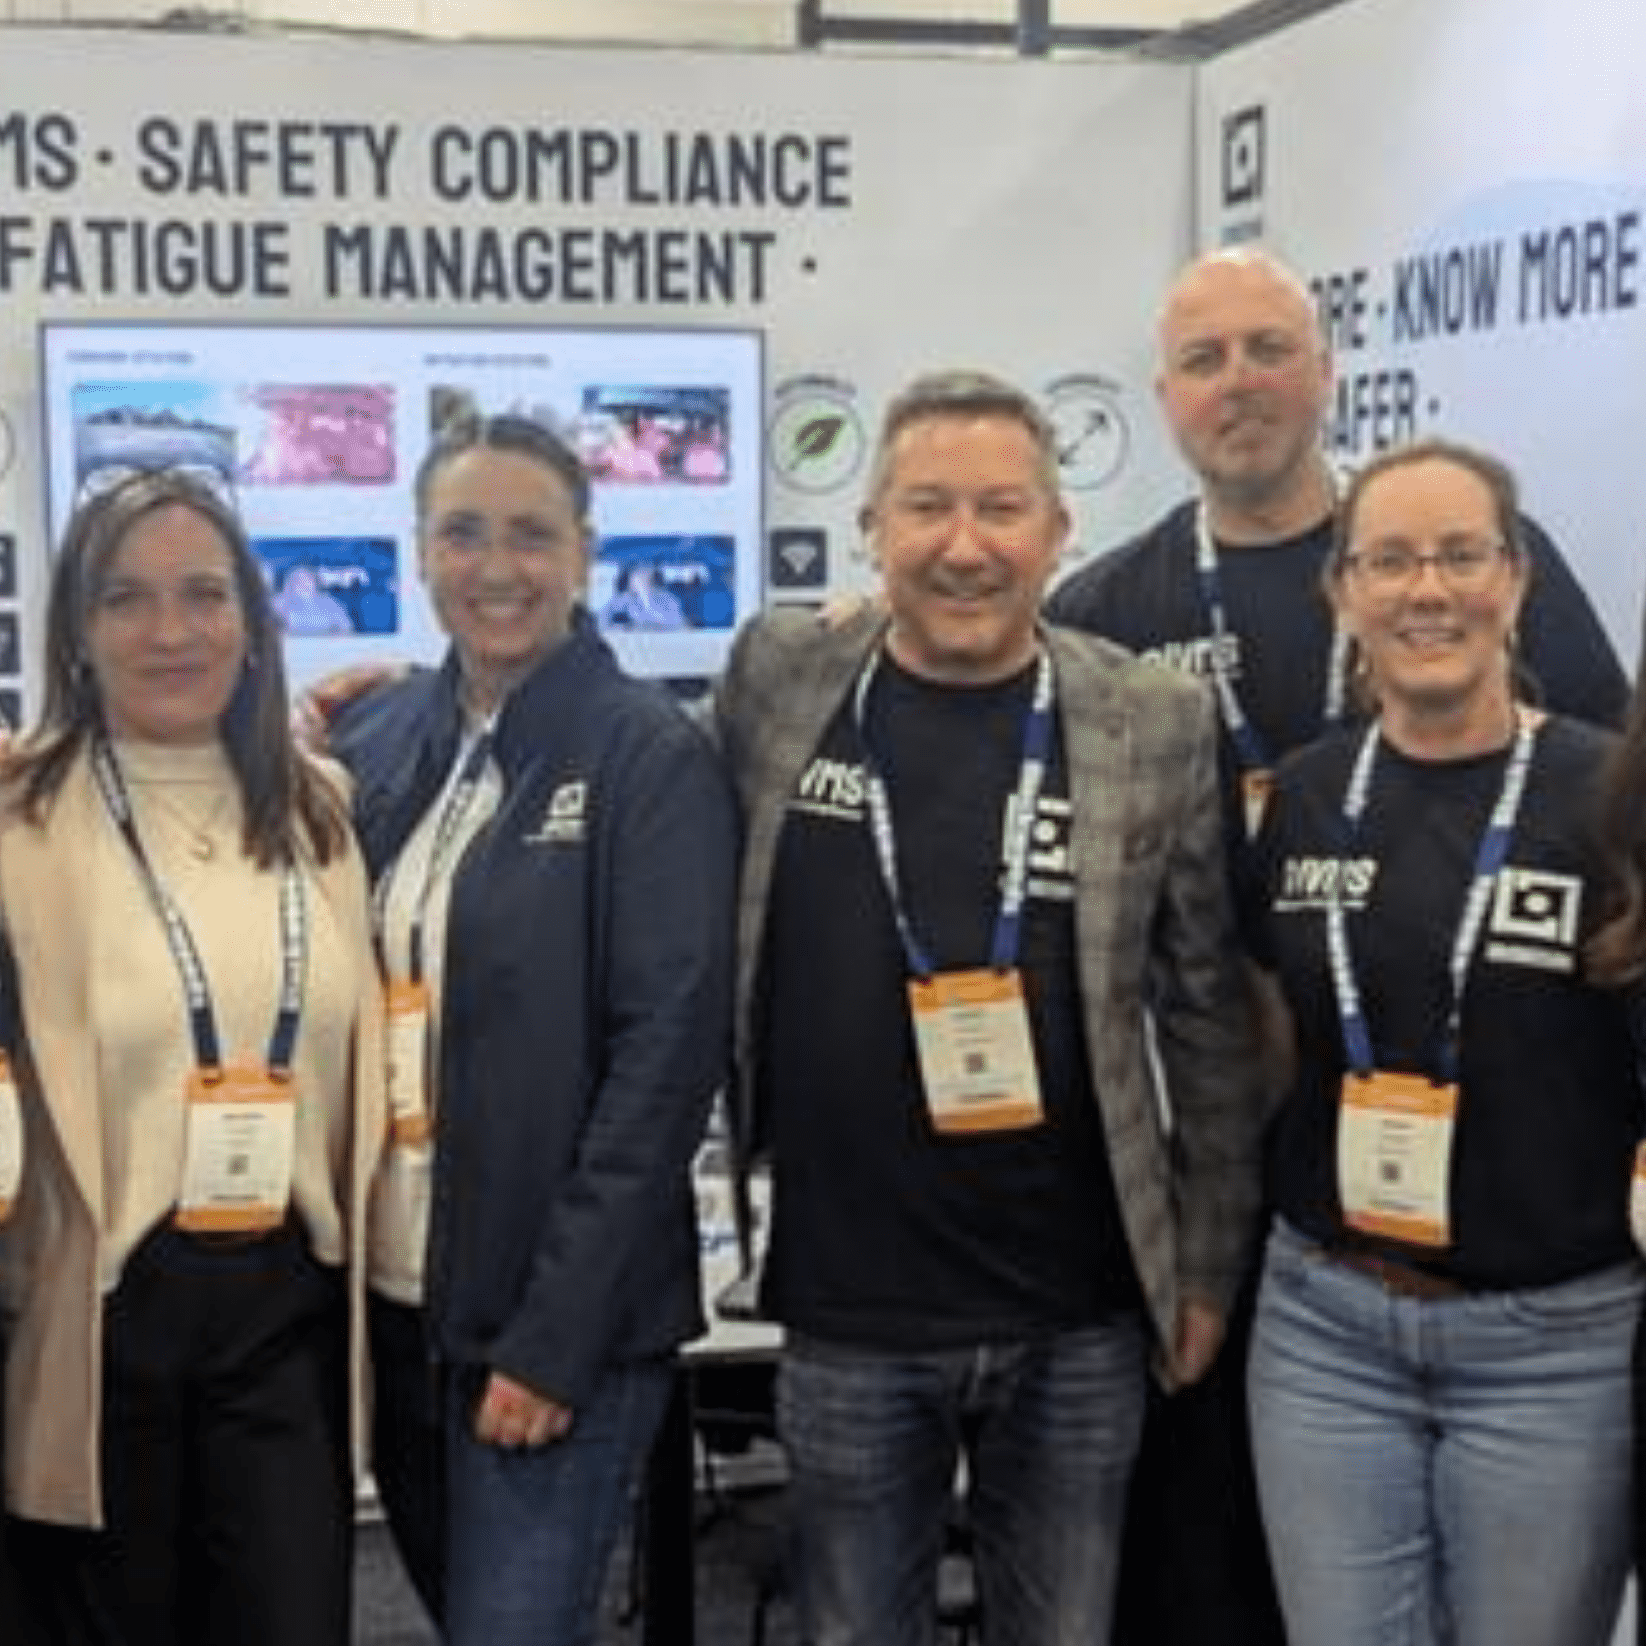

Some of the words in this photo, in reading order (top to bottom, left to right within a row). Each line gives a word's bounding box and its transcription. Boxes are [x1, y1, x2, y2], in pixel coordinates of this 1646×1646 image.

[138, 118, 399, 199] SAFETY
[431, 125, 852, 209] COMPLIANCE
[323, 223, 776, 304] MANAGEMENT
[1392, 240, 1505, 344] KNOW
[1518, 211, 1640, 326] MORE
[1321, 368, 1416, 453] AFER
